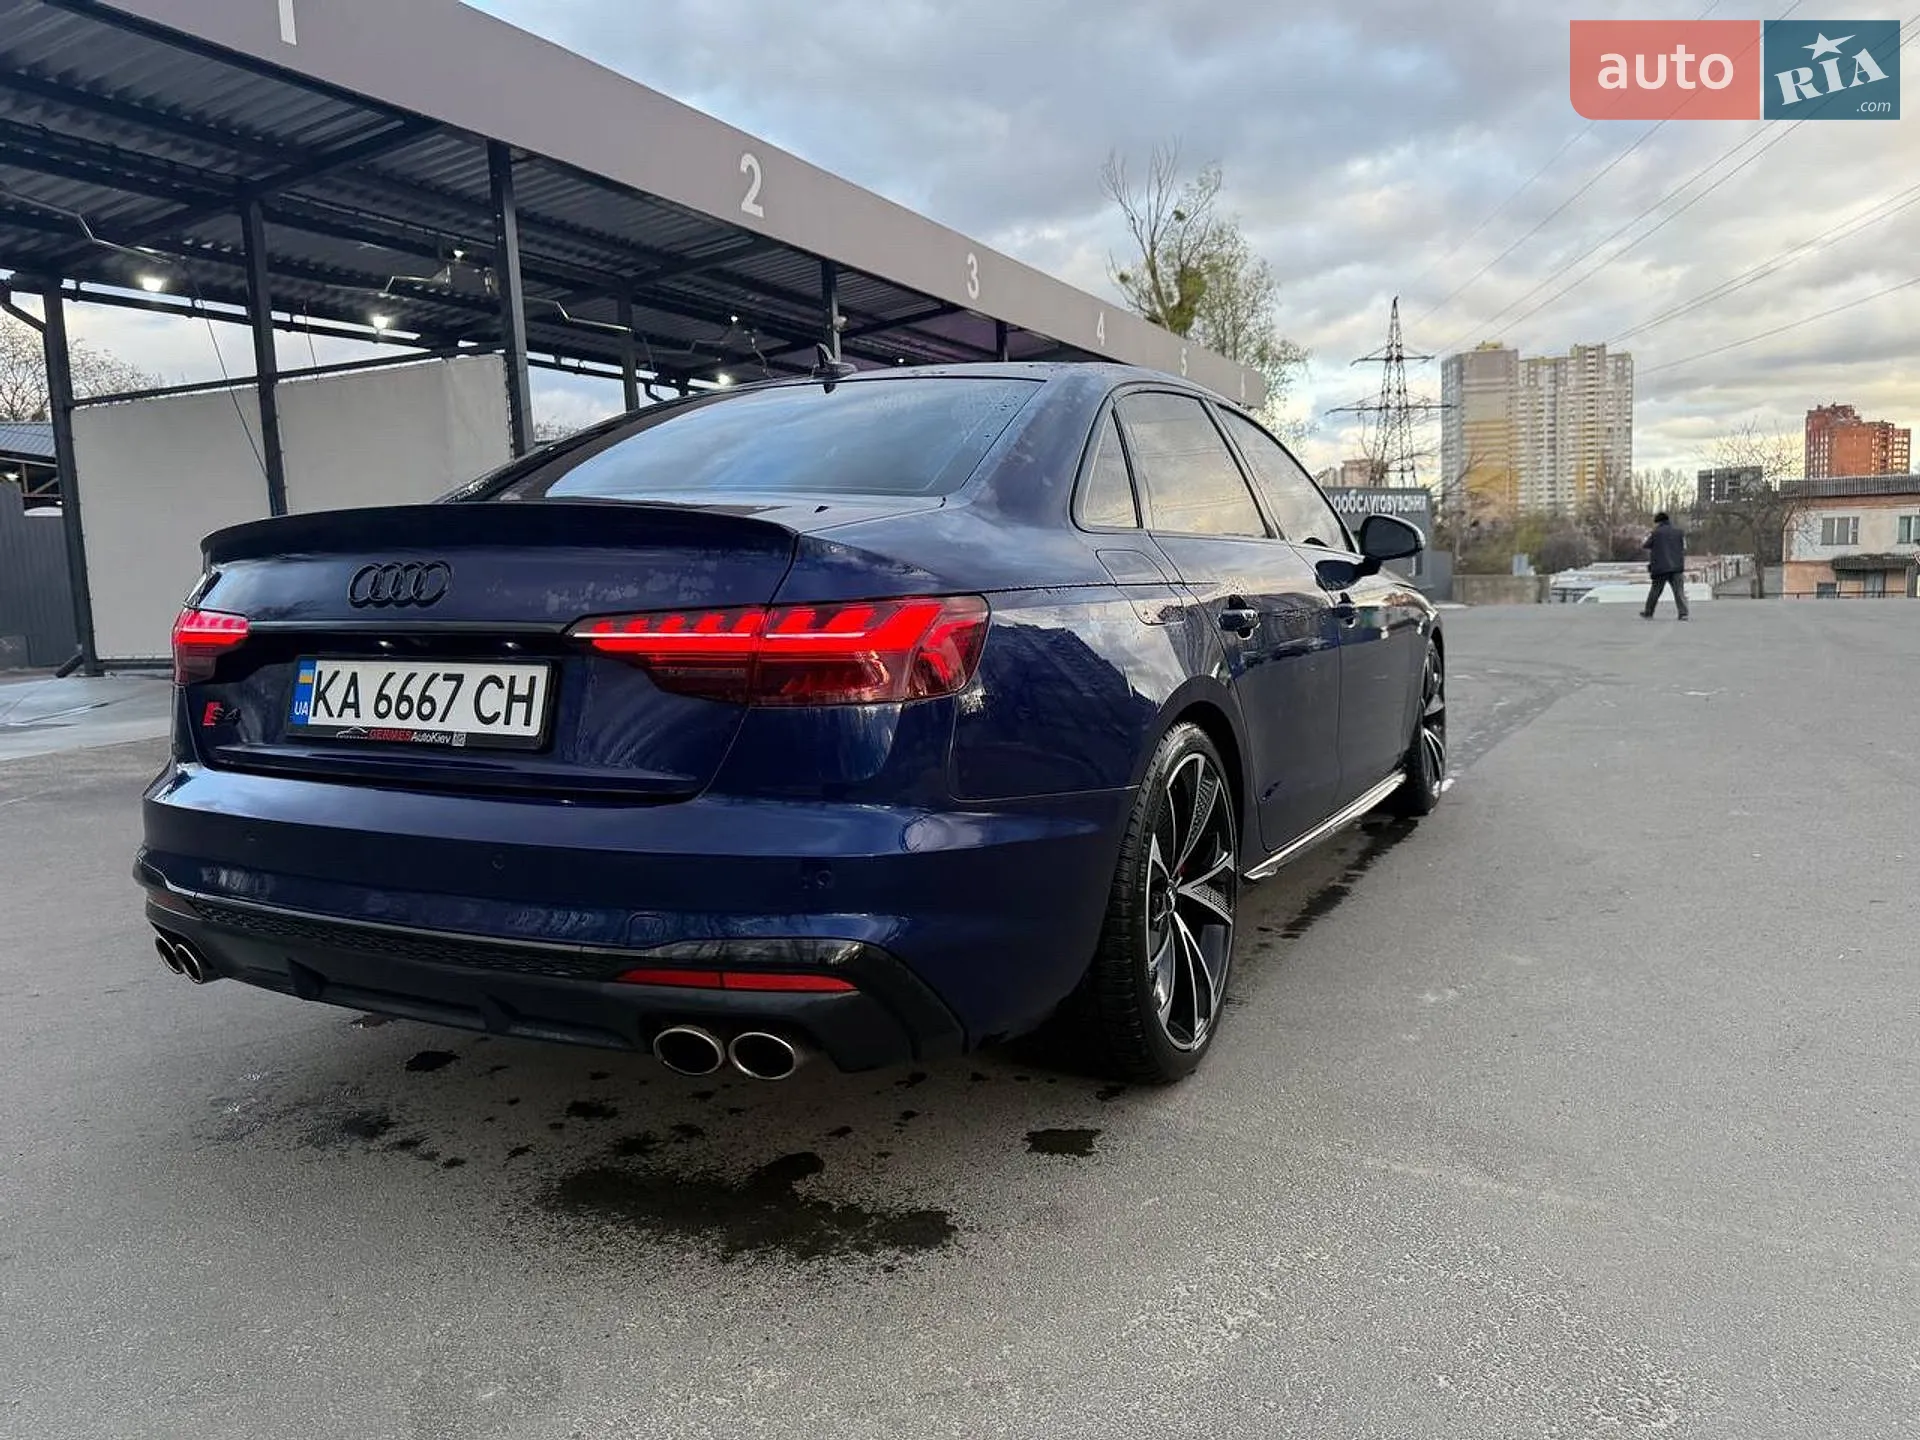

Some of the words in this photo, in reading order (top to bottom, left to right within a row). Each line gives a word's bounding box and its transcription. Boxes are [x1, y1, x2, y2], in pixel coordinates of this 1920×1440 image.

[739, 152, 764, 218] 2
[966, 252, 980, 300] 3
[1096, 312, 1105, 347] 4
[294, 701, 309, 715] UA
[312, 670, 361, 719] KA
[373, 672, 464, 723] 6667
[474, 674, 537, 727] CH
